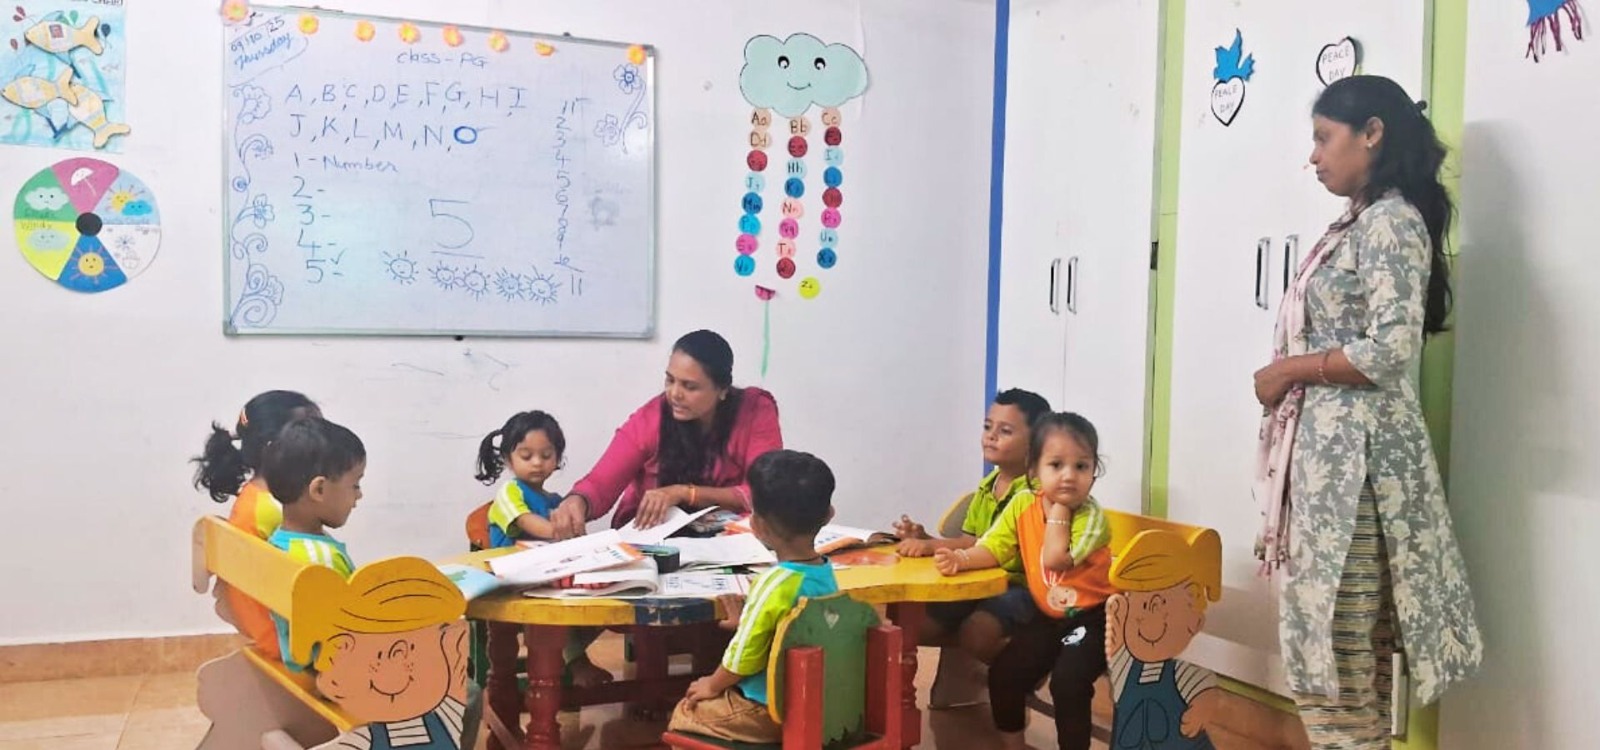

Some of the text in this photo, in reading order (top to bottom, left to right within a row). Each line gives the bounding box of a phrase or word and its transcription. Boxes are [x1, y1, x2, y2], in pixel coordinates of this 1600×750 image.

[1322, 46, 1350, 64] PEACE
[1329, 67, 1347, 81] DAY
[751, 111, 767, 126] Aa
[789, 119, 807, 134] Bb
[429, 198, 475, 249] 5
